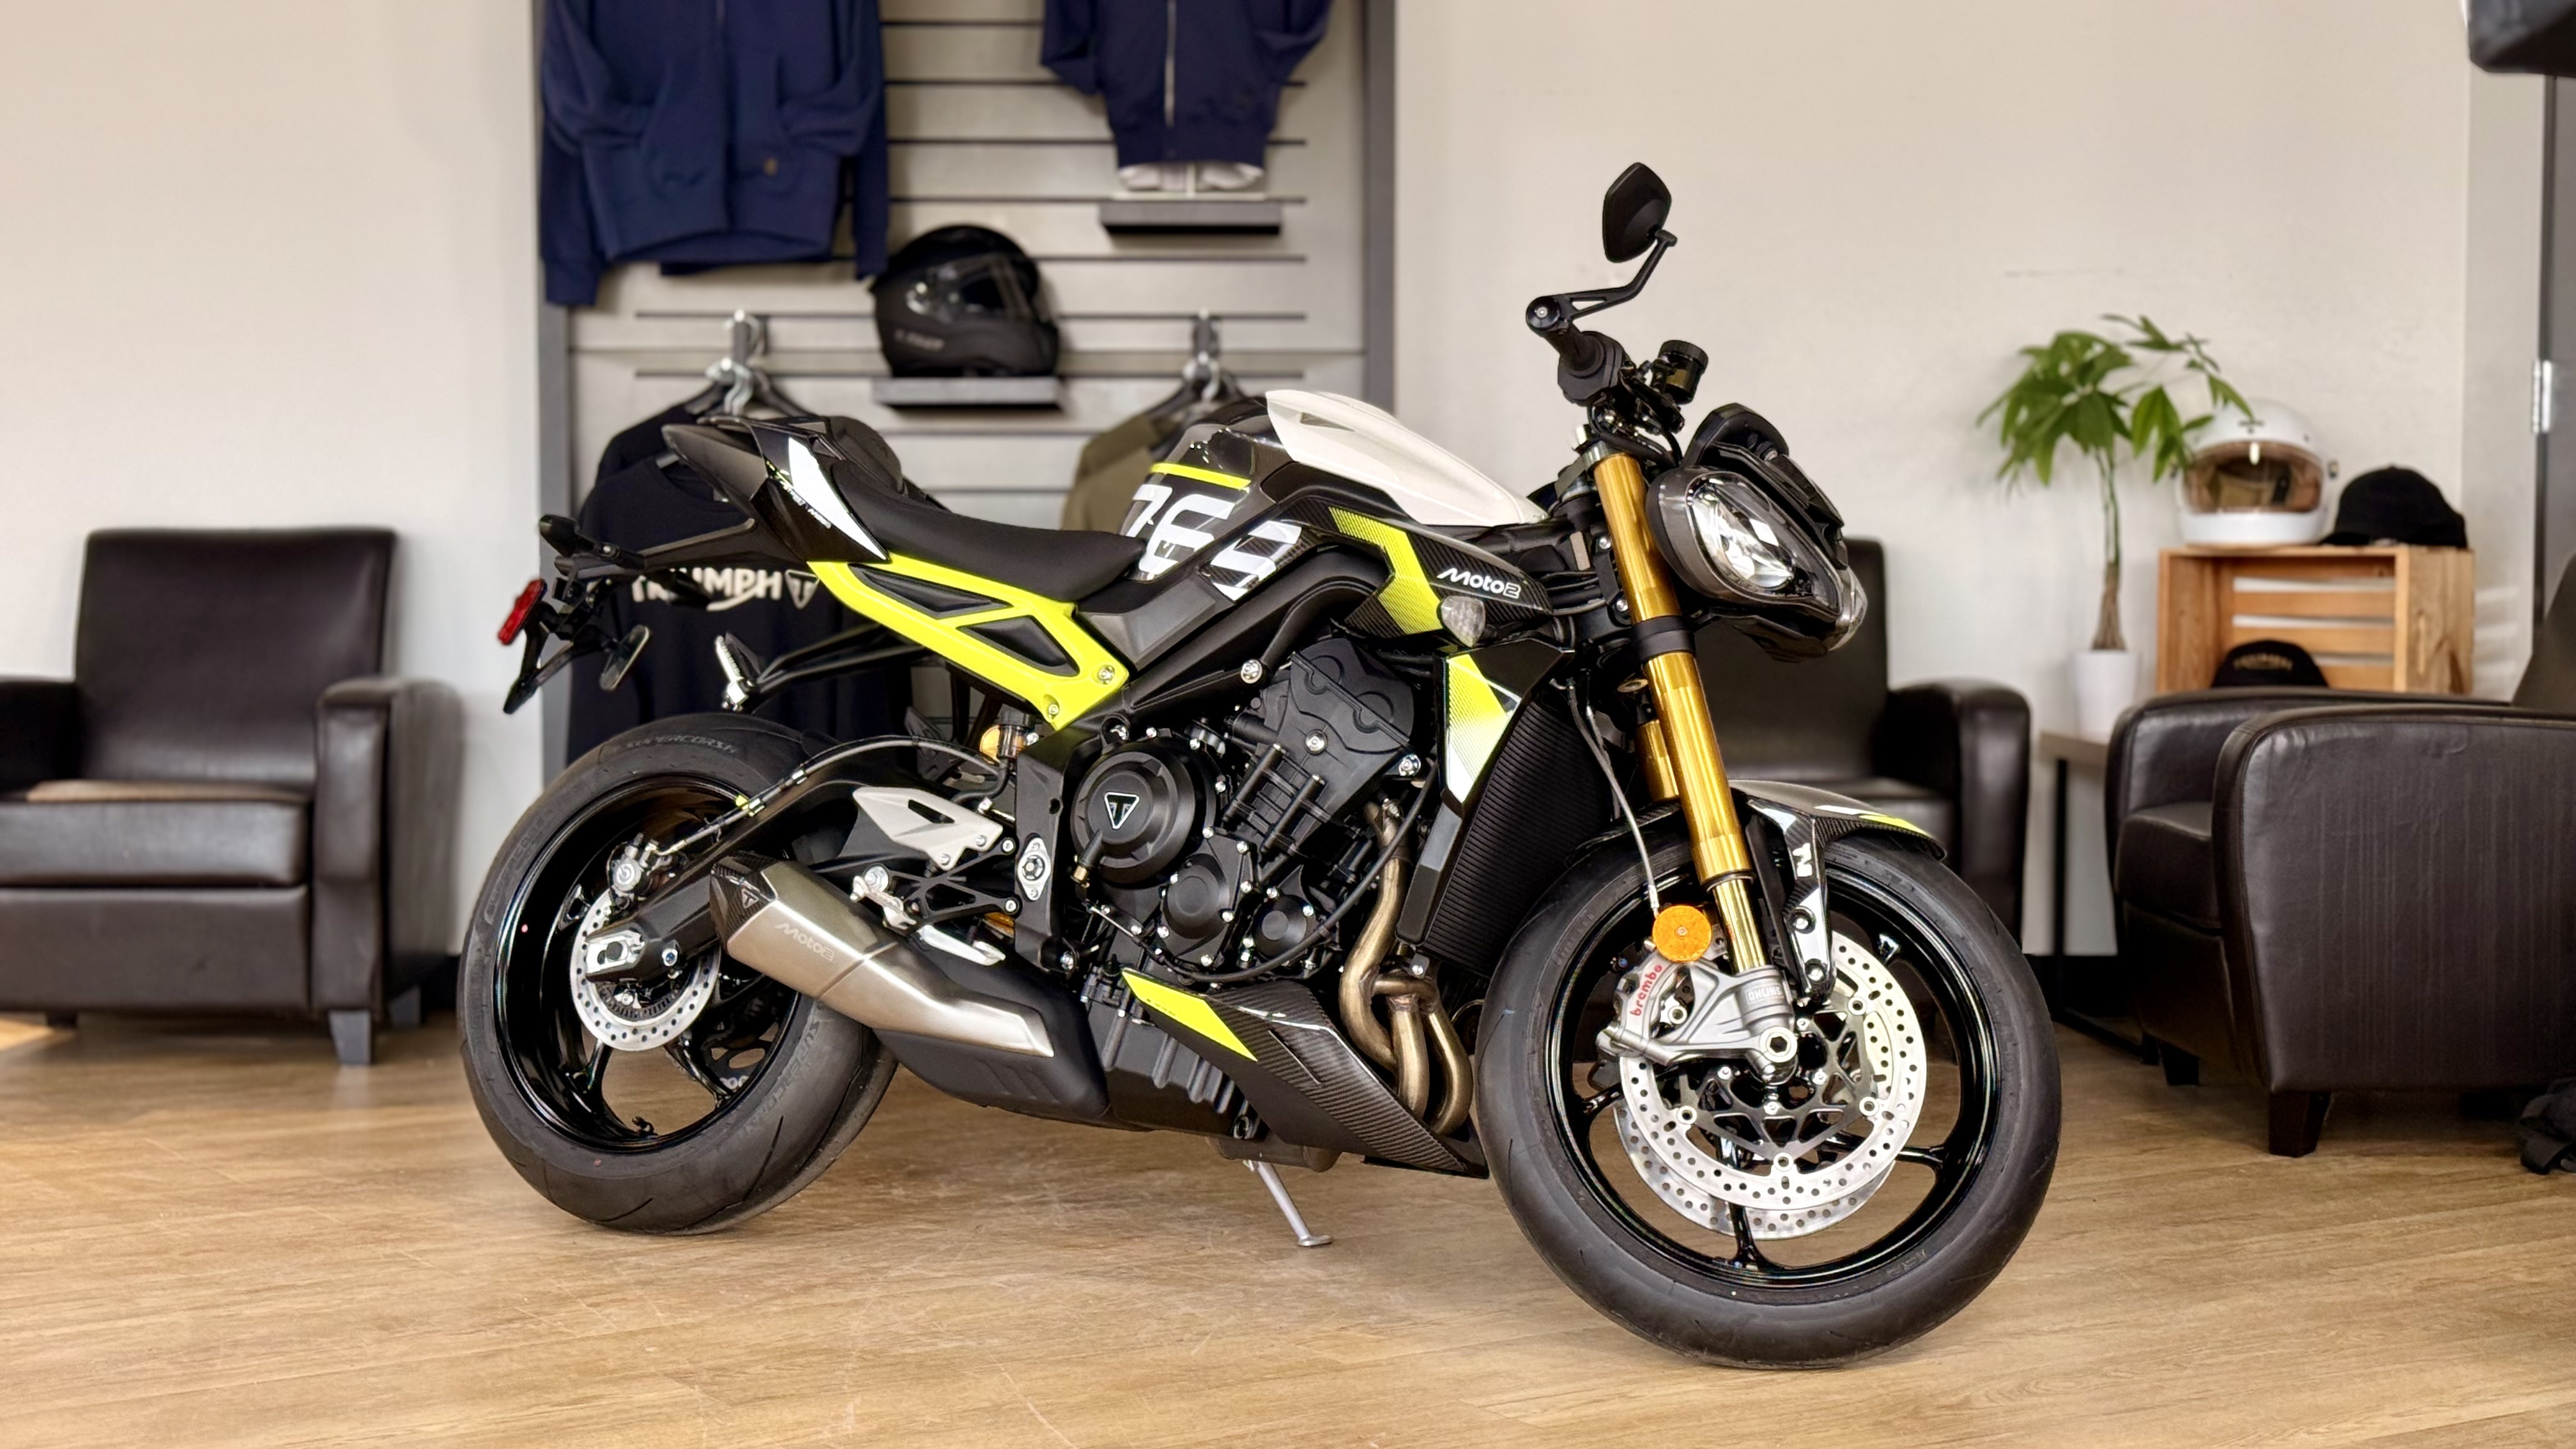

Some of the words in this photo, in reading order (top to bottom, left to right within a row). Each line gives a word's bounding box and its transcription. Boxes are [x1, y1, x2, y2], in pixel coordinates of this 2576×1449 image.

[1437, 567, 1522, 599] Moto2
[774, 923, 834, 962] Moto2
[1629, 965, 1662, 1016] brembo
